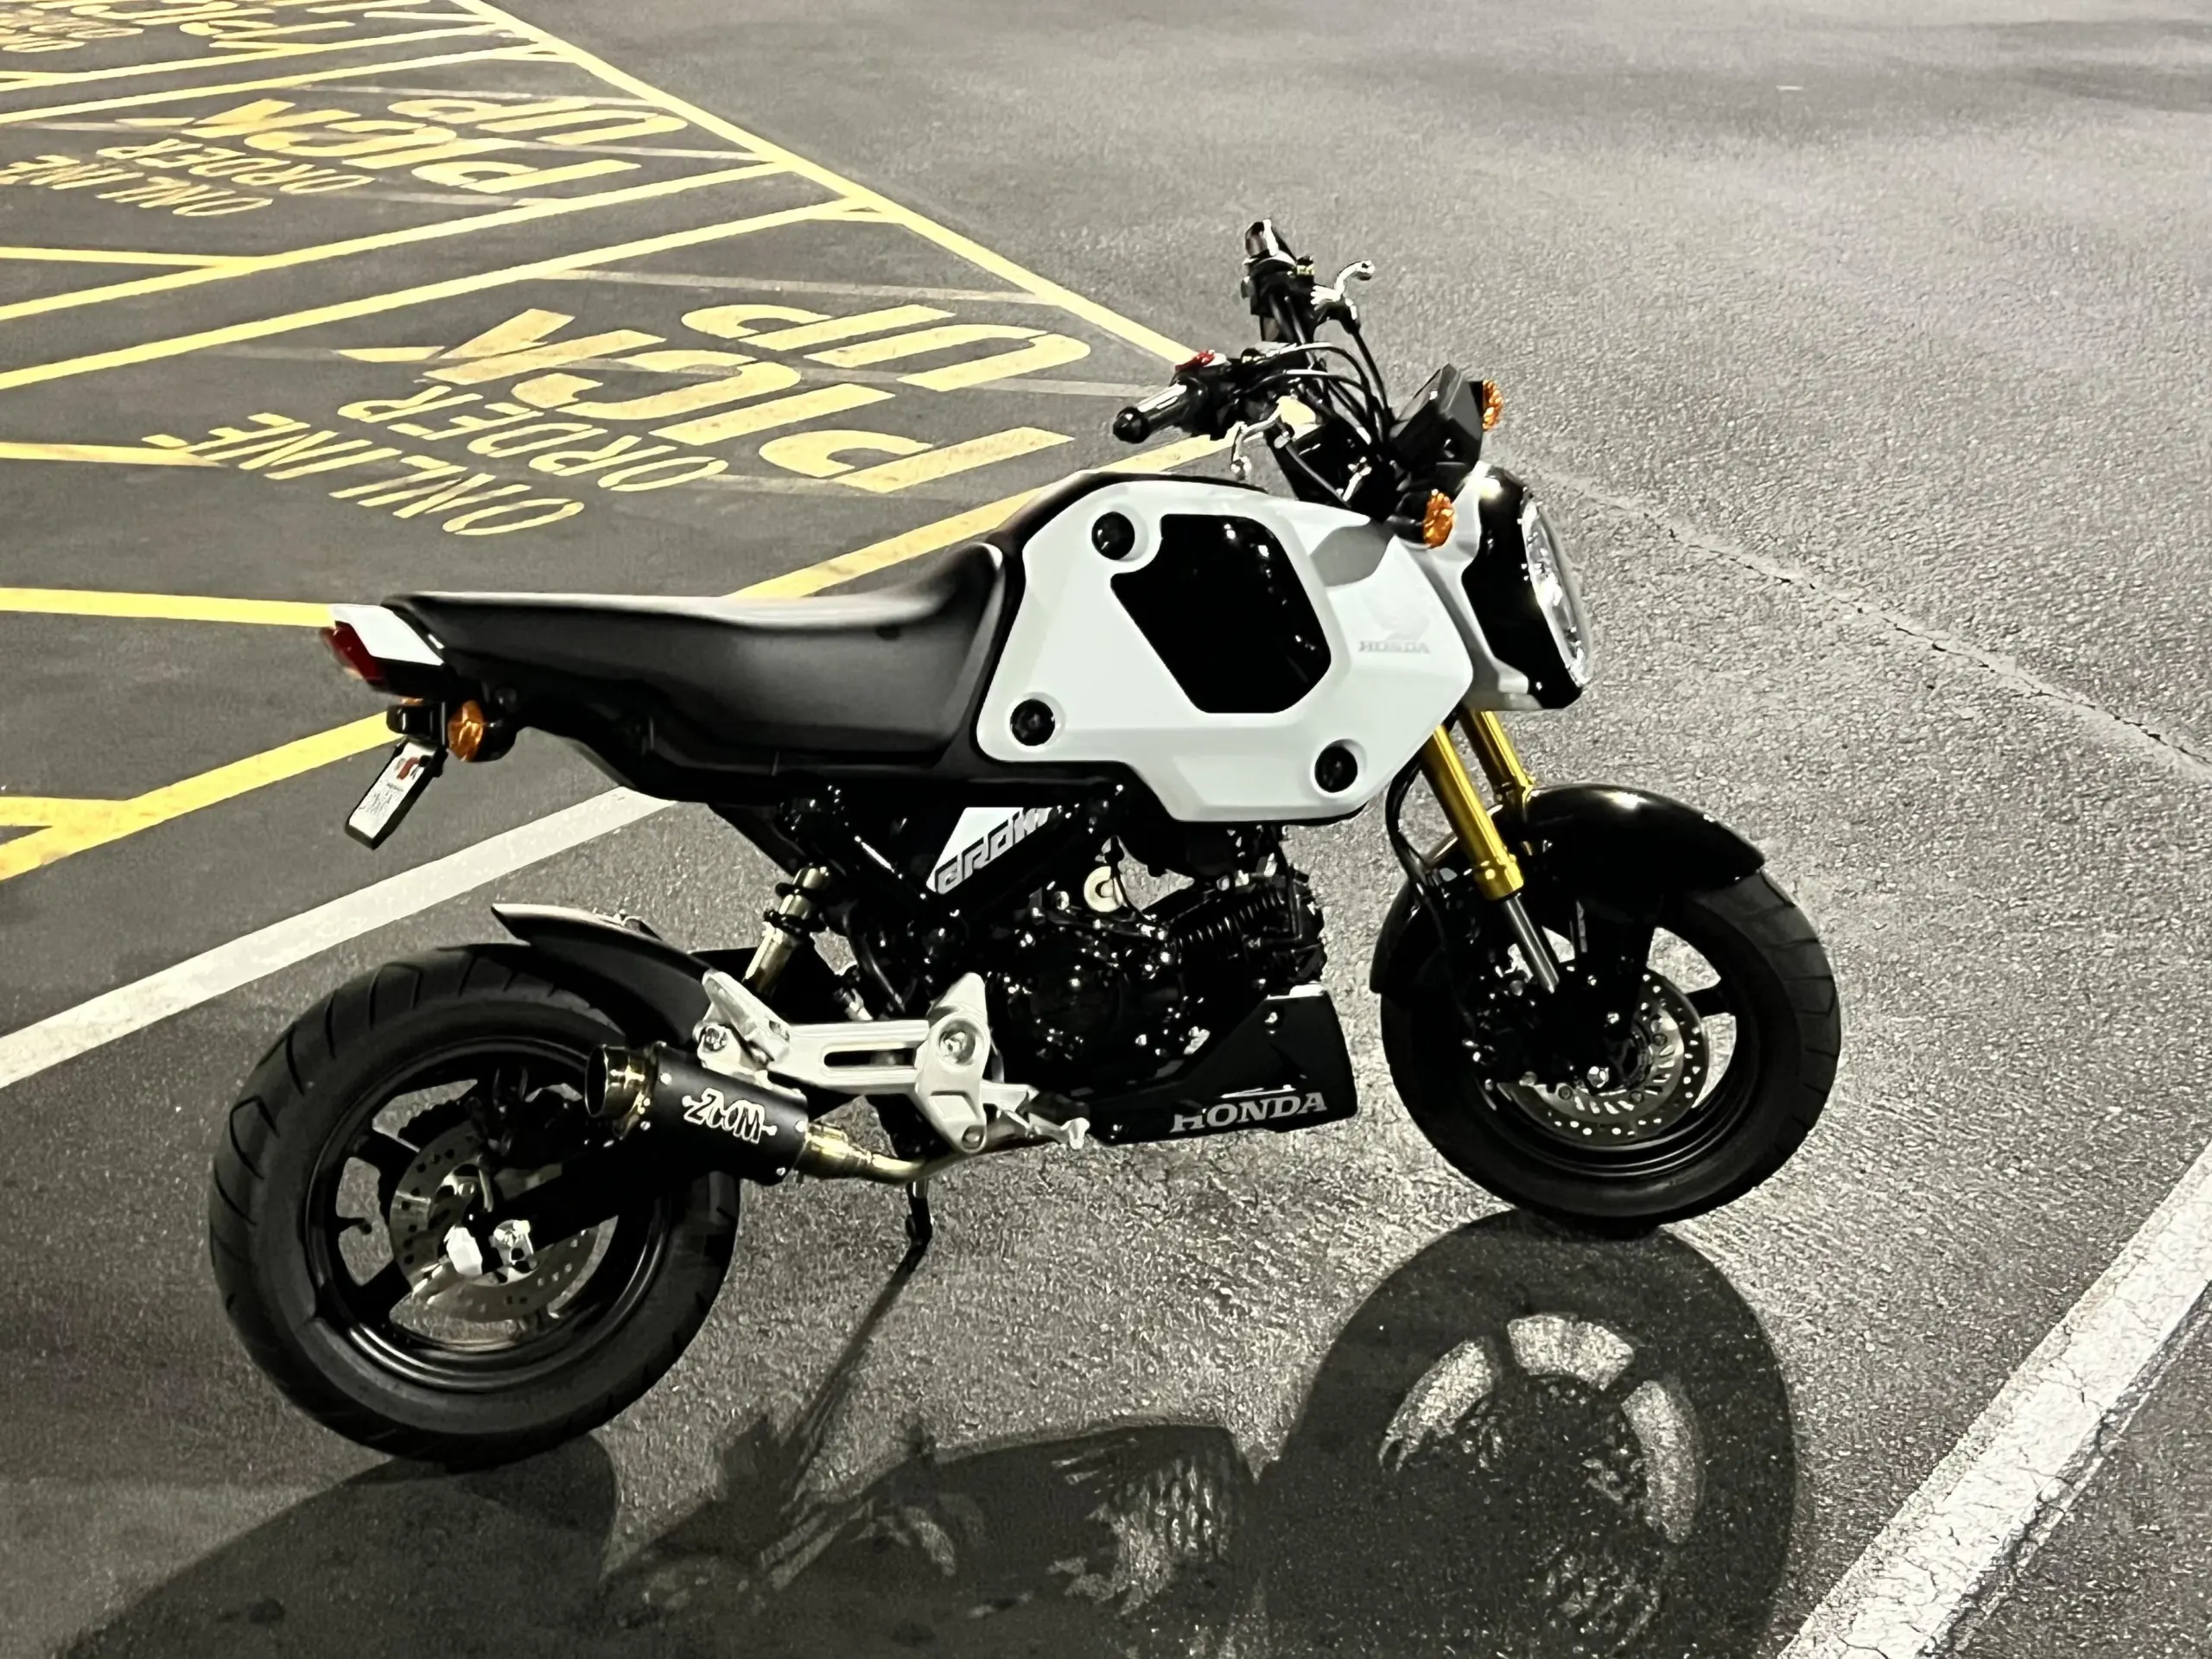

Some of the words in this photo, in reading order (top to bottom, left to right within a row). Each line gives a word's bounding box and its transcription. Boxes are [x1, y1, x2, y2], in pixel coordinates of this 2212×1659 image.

[115, 99, 642, 194] PICK
[681, 303, 1091, 392] UP
[332, 307, 1076, 493] PICK
[338, 384, 730, 493] ORDER
[141, 412, 585, 537] ONLINE
[1358, 639, 1431, 654] HONDA
[1169, 1091, 1328, 1134] HONDA
